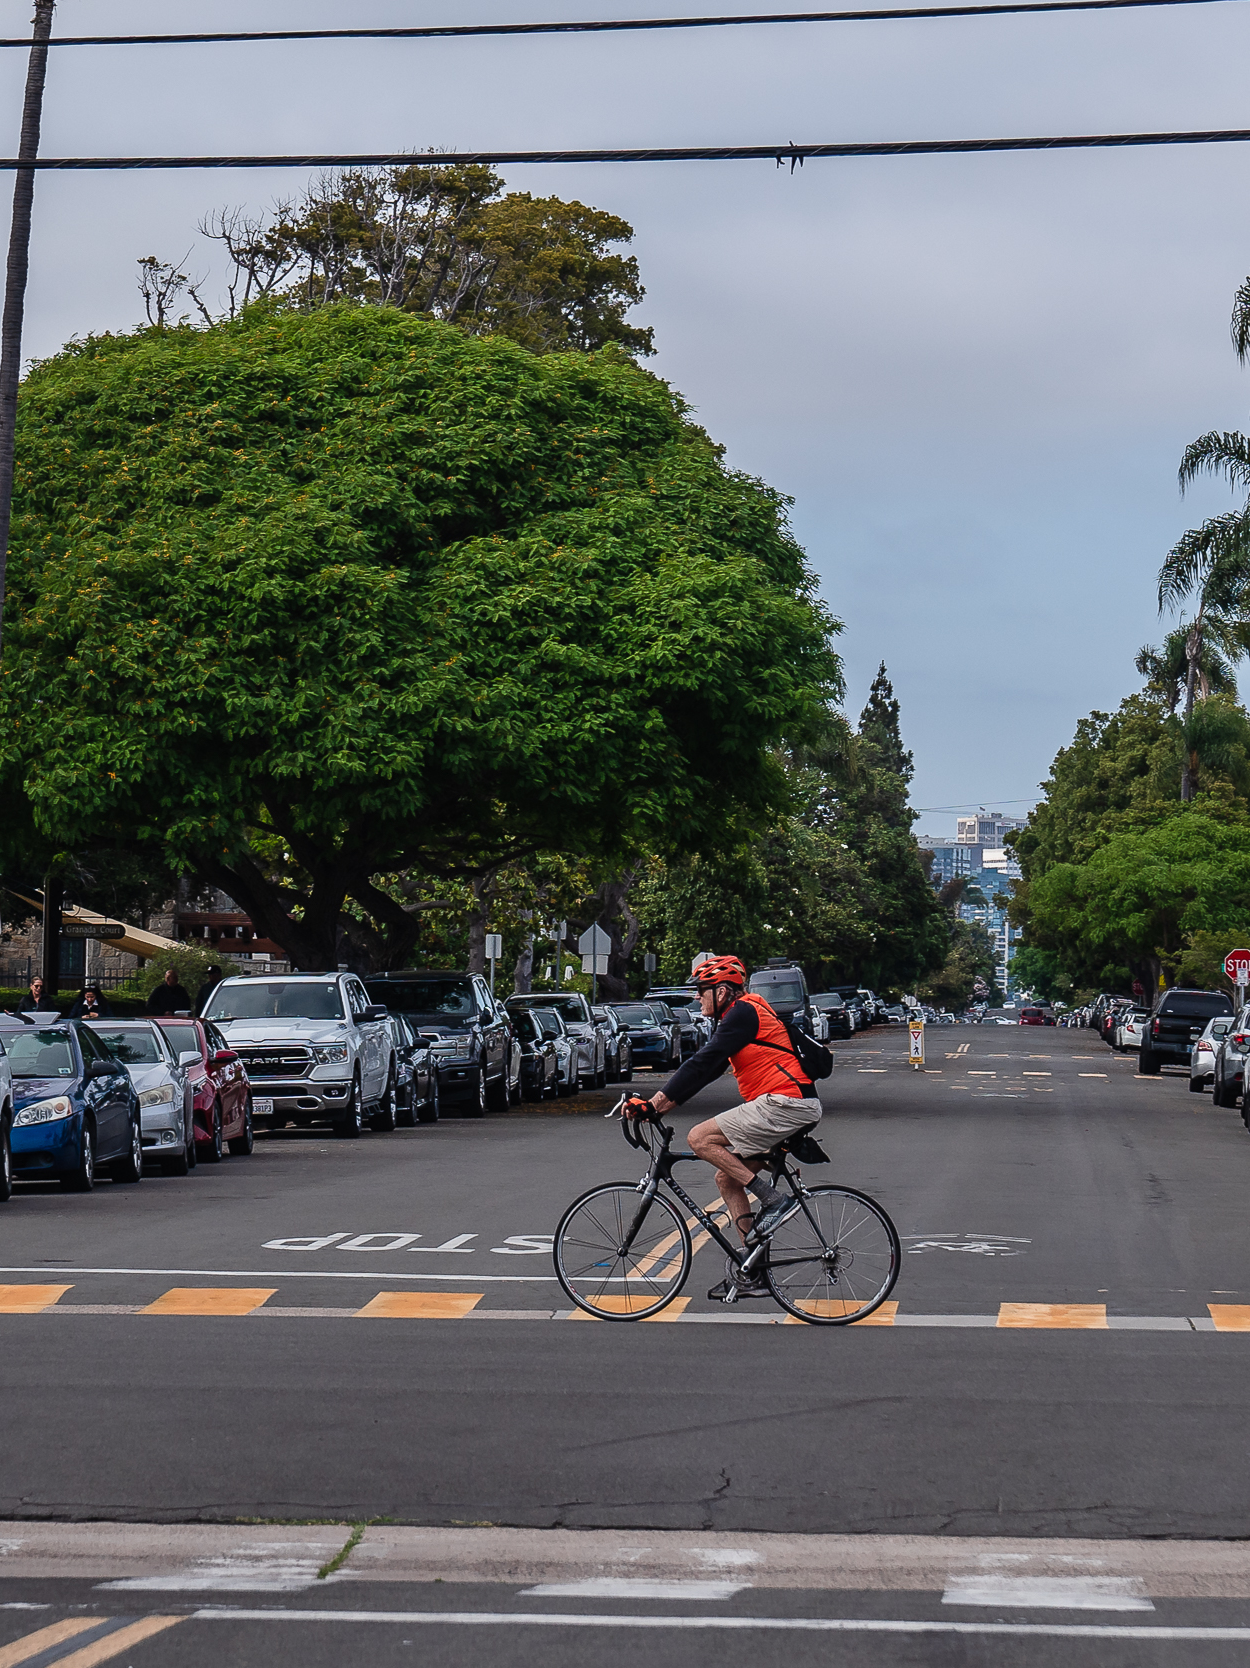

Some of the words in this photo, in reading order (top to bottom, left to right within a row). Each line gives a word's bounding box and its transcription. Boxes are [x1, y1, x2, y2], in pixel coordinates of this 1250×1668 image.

[66, 925, 96, 934] Granada
[100, 926, 121, 934] Court
[1227, 959, 1250, 972] STO
[261, 1232, 572, 1254] STOP
